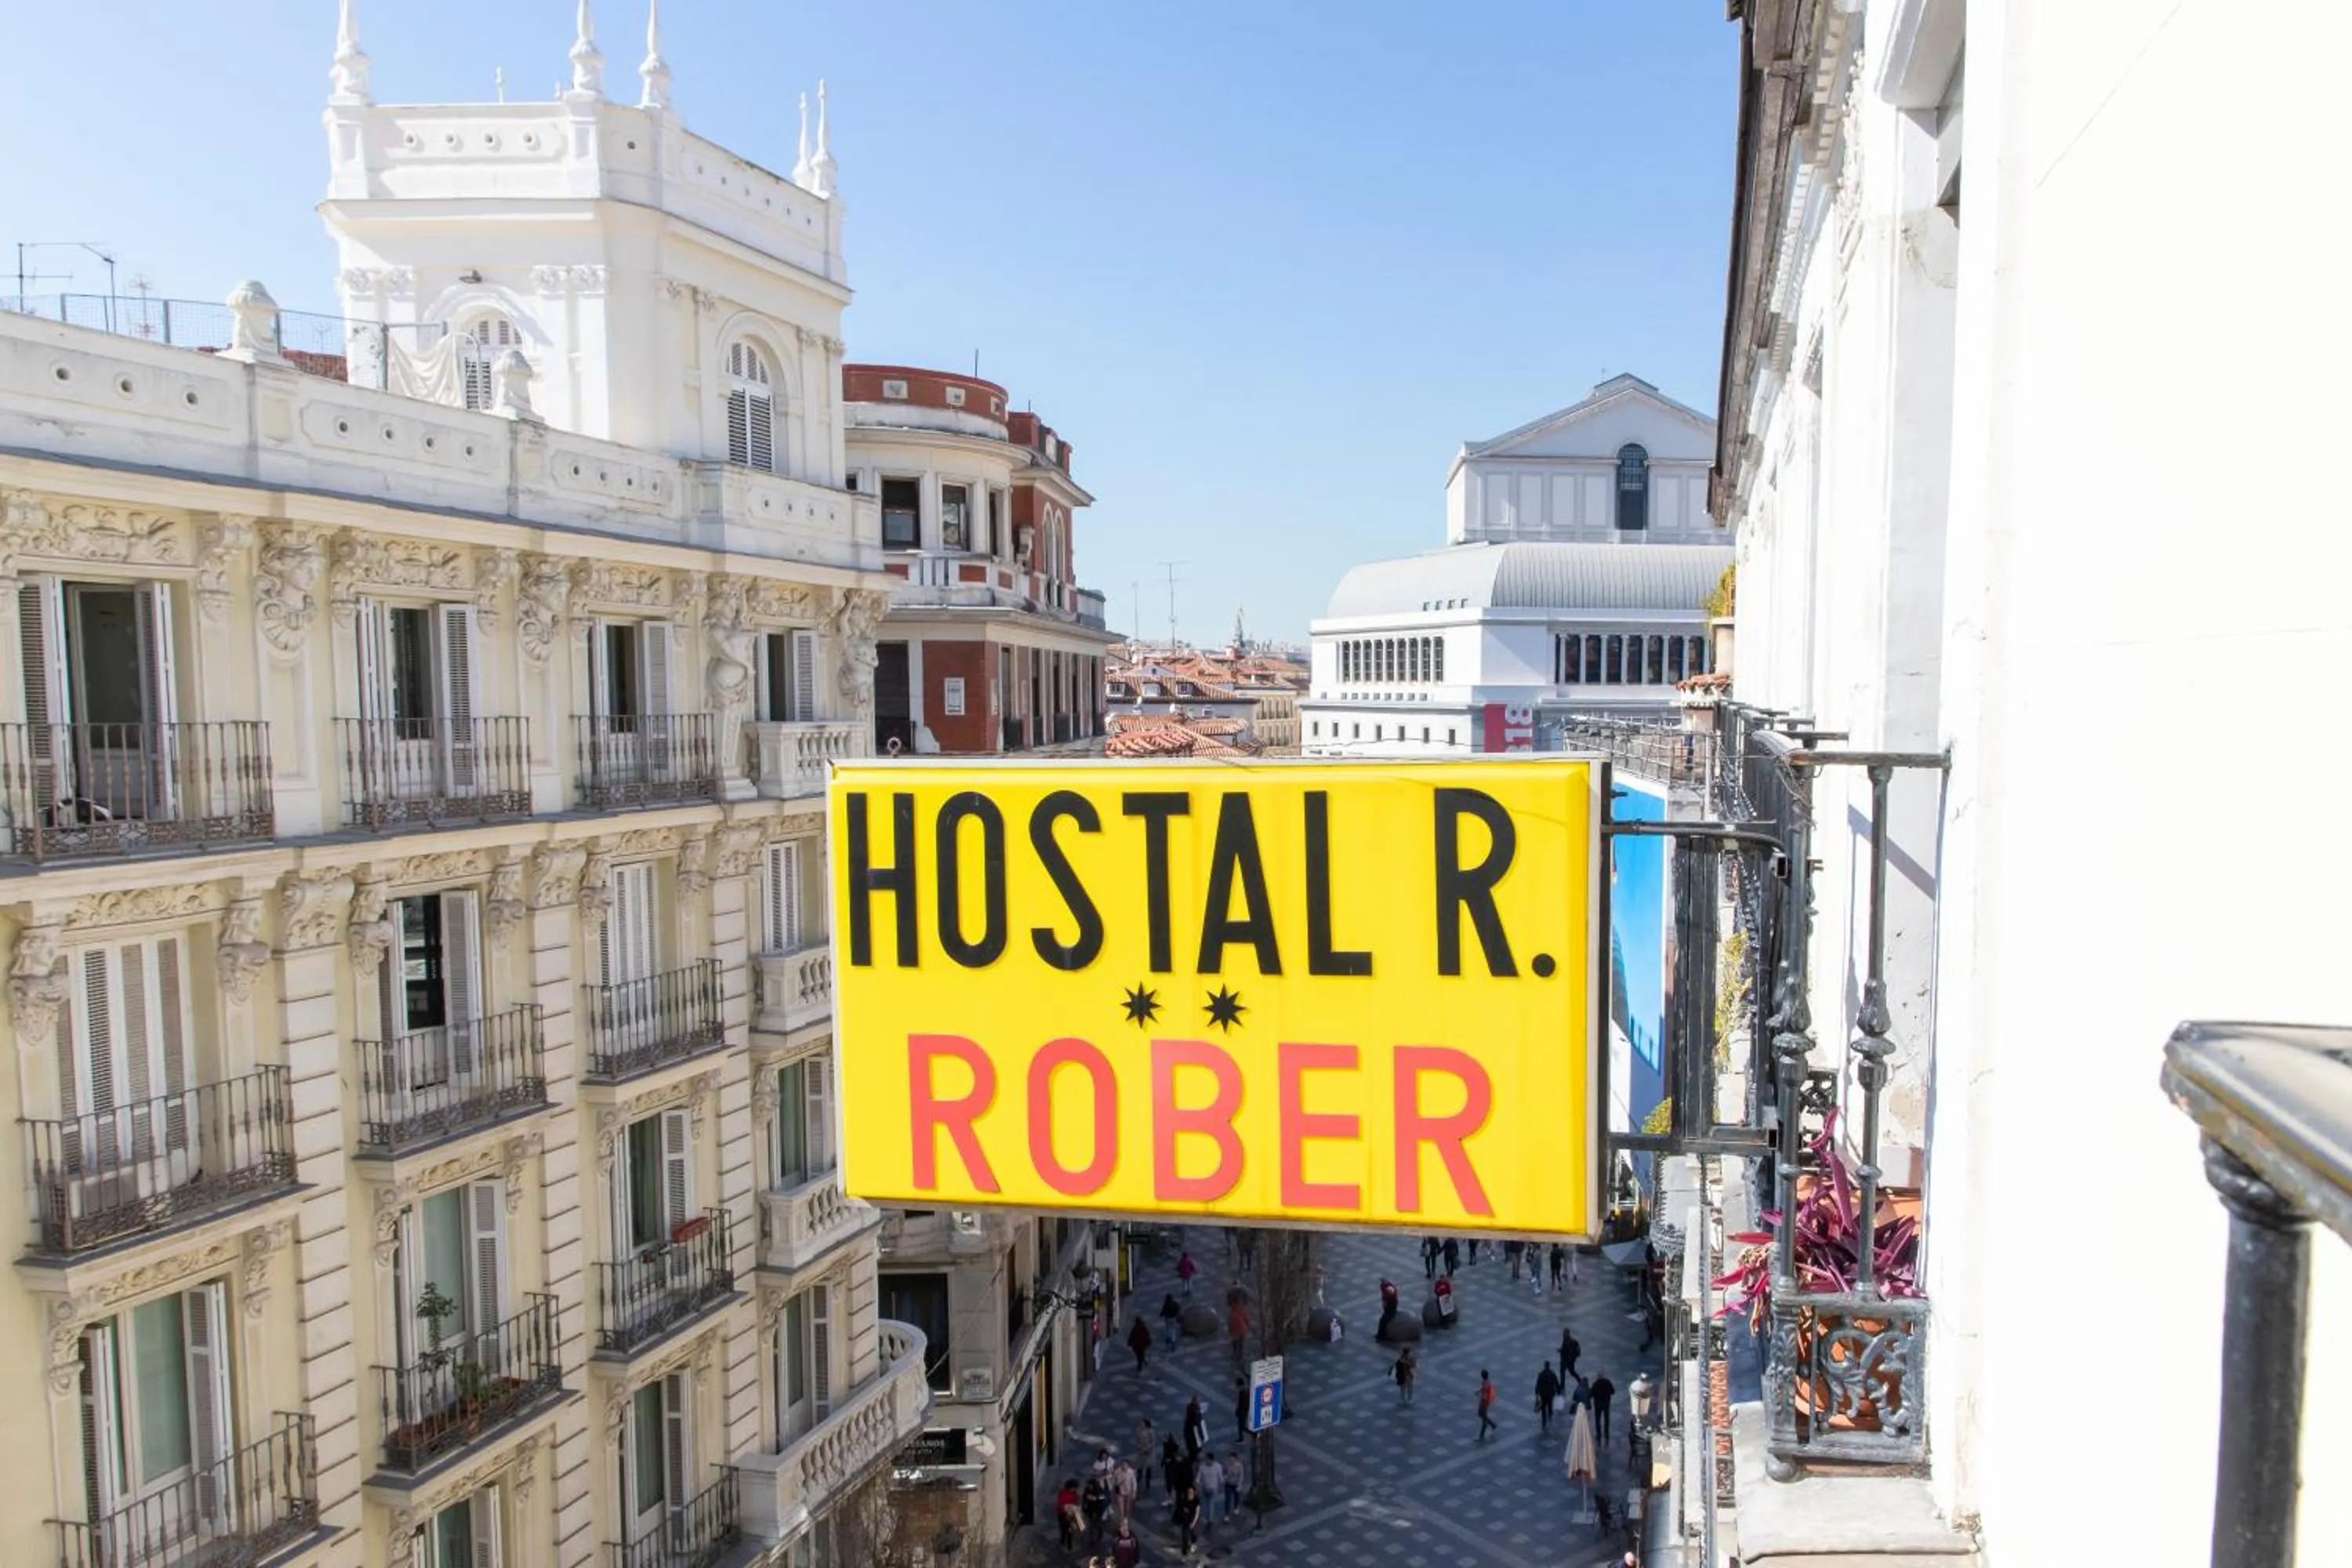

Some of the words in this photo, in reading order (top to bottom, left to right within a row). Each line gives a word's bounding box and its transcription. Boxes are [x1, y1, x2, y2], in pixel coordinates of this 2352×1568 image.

[847, 789, 1373, 976] HOSTAL
[1434, 788, 1556, 978] R.
[907, 1034, 1494, 1216] ROBER
